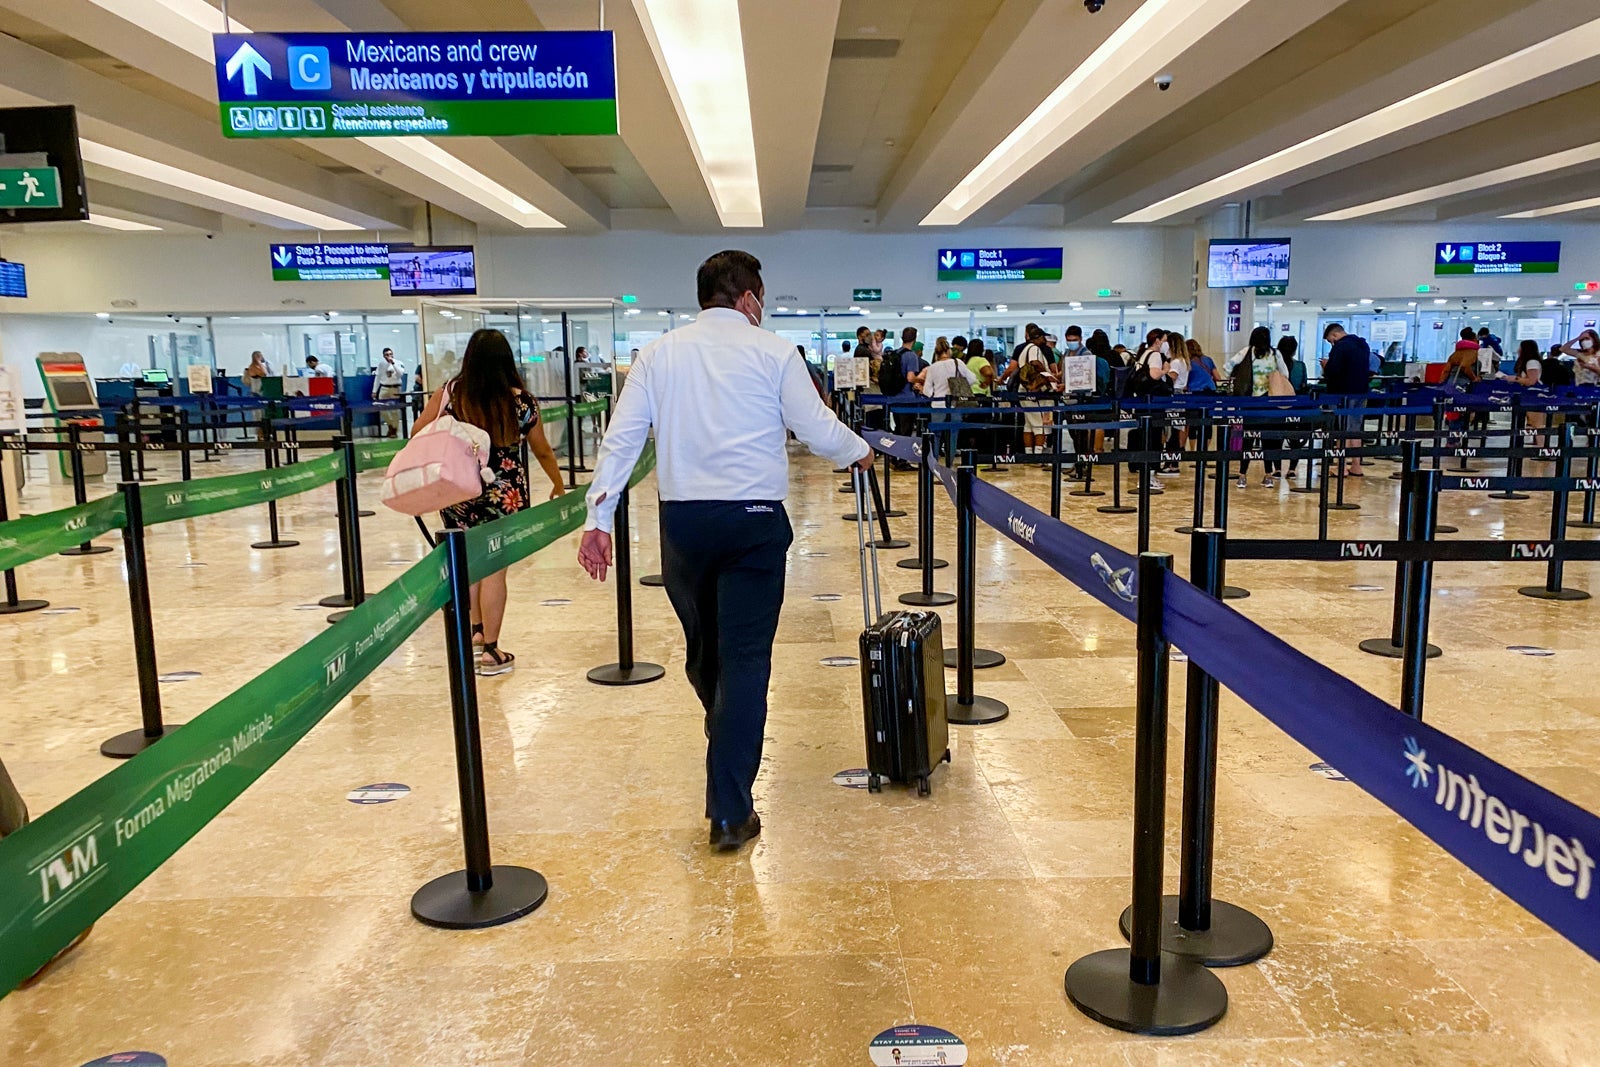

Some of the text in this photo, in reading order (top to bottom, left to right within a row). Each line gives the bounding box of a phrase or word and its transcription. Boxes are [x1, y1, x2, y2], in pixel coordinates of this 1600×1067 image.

[346, 40, 538, 63] Mexicans and crew
[298, 53, 321, 82] C
[350, 65, 589, 94] Mexicanos y tripulación
[332, 104, 424, 118] Special assistance
[332, 117, 448, 132] Atenciones especiales
[296, 245, 388, 256] Step 2. Proceed to intervi
[979, 250, 1002, 258] Block 1
[1478, 252, 1500, 261] Bloque
[296, 256, 316, 264] Paso
[324, 256, 344, 264] Pase
[350, 255, 389, 264] entrevista
[979, 259, 1002, 268] Bloque
[355, 634, 374, 658] Forma
[114, 797, 165, 847] Forma
[166, 744, 232, 807] Migratoria
[232, 712, 274, 758] Múltiple
[1435, 764, 1596, 900] interjet
